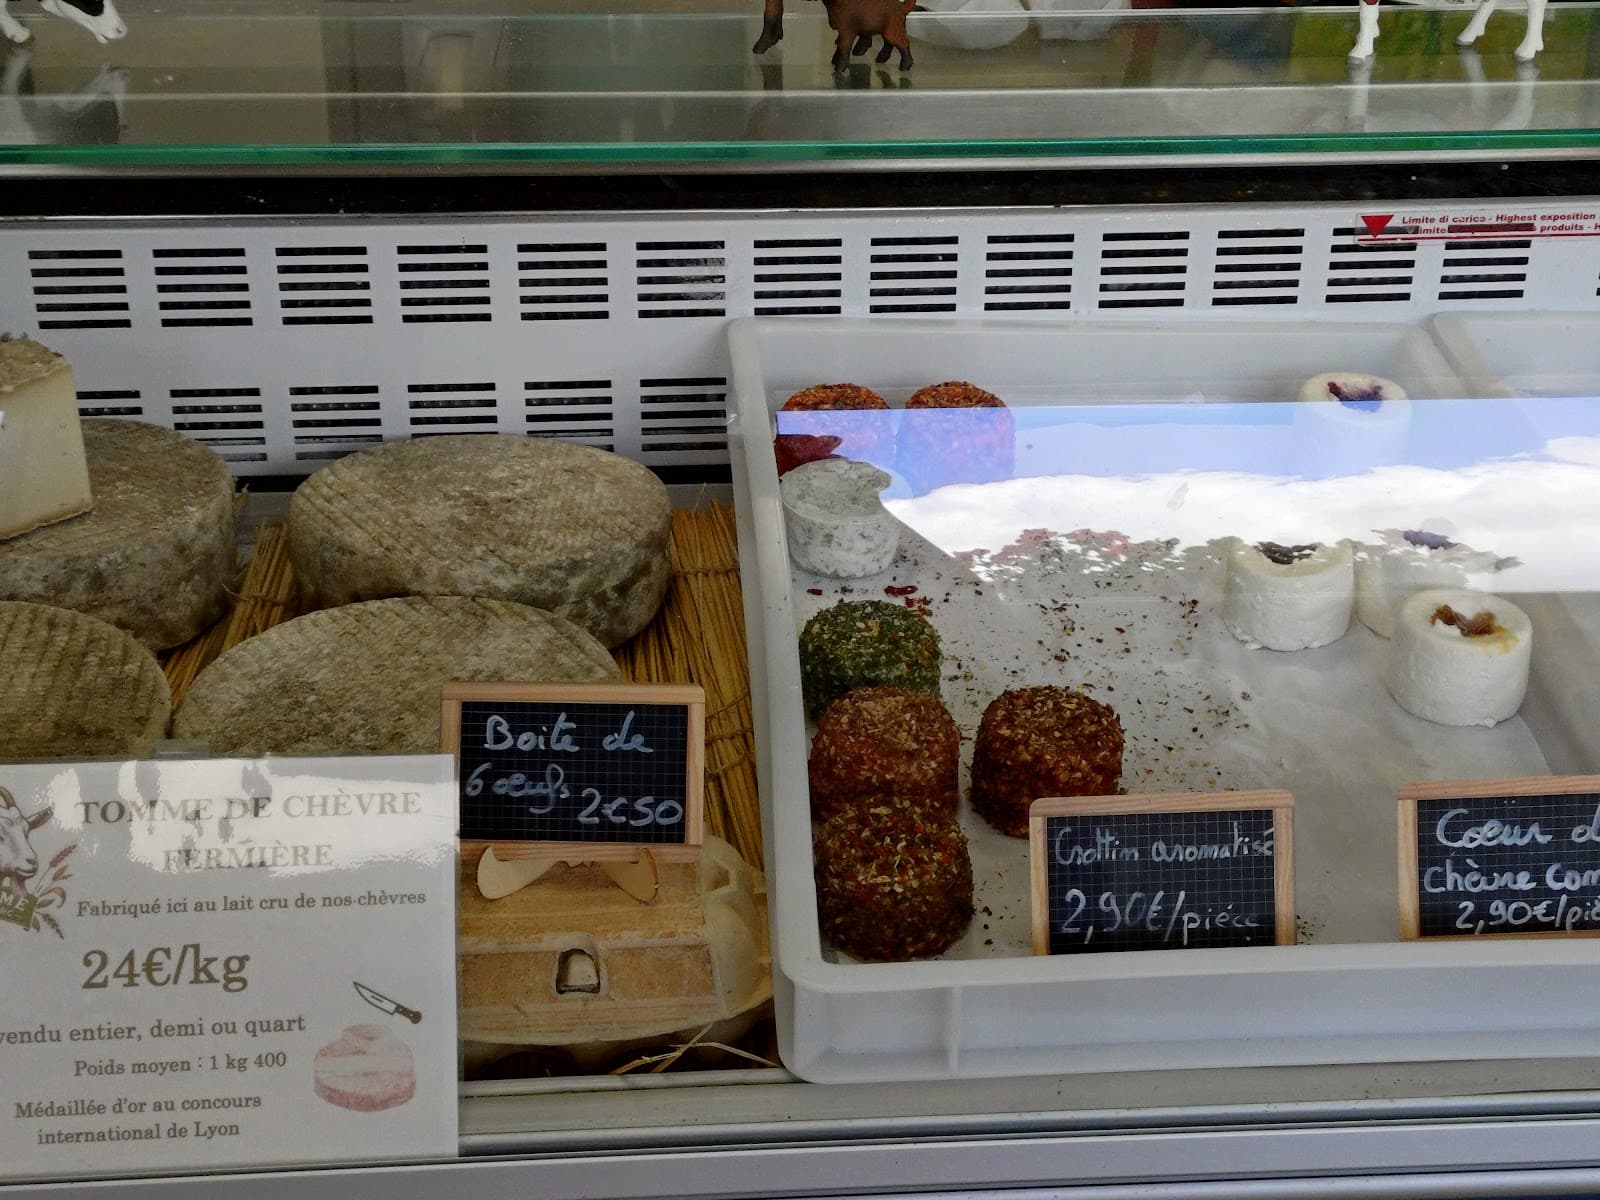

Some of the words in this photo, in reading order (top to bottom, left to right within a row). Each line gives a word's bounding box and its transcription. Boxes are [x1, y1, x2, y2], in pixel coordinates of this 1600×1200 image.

[1402, 216, 1435, 224] Limite
[1496, 213, 1537, 224] Highest
[1540, 212, 1596, 222] exposition
[1540, 223, 1584, 233] produits
[602, 710, 654, 753] de
[466, 762, 492, 797] 6
[74, 796, 213, 825] TOMME
[222, 797, 271, 820] DE
[282, 788, 421, 818] CHÈVRE
[163, 842, 333, 872] FERMIÈRE
[77, 898, 161, 920] Fabriqué
[167, 897, 188, 913] ici
[193, 899, 217, 912] au
[223, 894, 254, 911] lait
[259, 897, 288, 910] cru
[294, 892, 316, 908] de
[321, 893, 352, 907] nos
[357, 890, 427, 906] chèvres
[81, 944, 251, 993] 24€/kg
[69, 1022, 142, 1042] entier,
[150, 1018, 204, 1038] demi
[211, 1020, 238, 1035] ou
[245, 1015, 306, 1036] quart
[73, 1058, 125, 1077] Poids
[131, 1061, 192, 1079] moyen
[209, 1055, 219, 1070] 1
[226, 1053, 248, 1073] kg
[253, 1051, 287, 1069] 400
[15, 1098, 106, 1119] Médaillée
[112, 1095, 147, 1114] d'or
[152, 1099, 175, 1112] au
[181, 1095, 262, 1111] concours
[37, 1124, 161, 1145] international
[166, 1122, 188, 1138] de
[194, 1121, 240, 1142] Lyon
